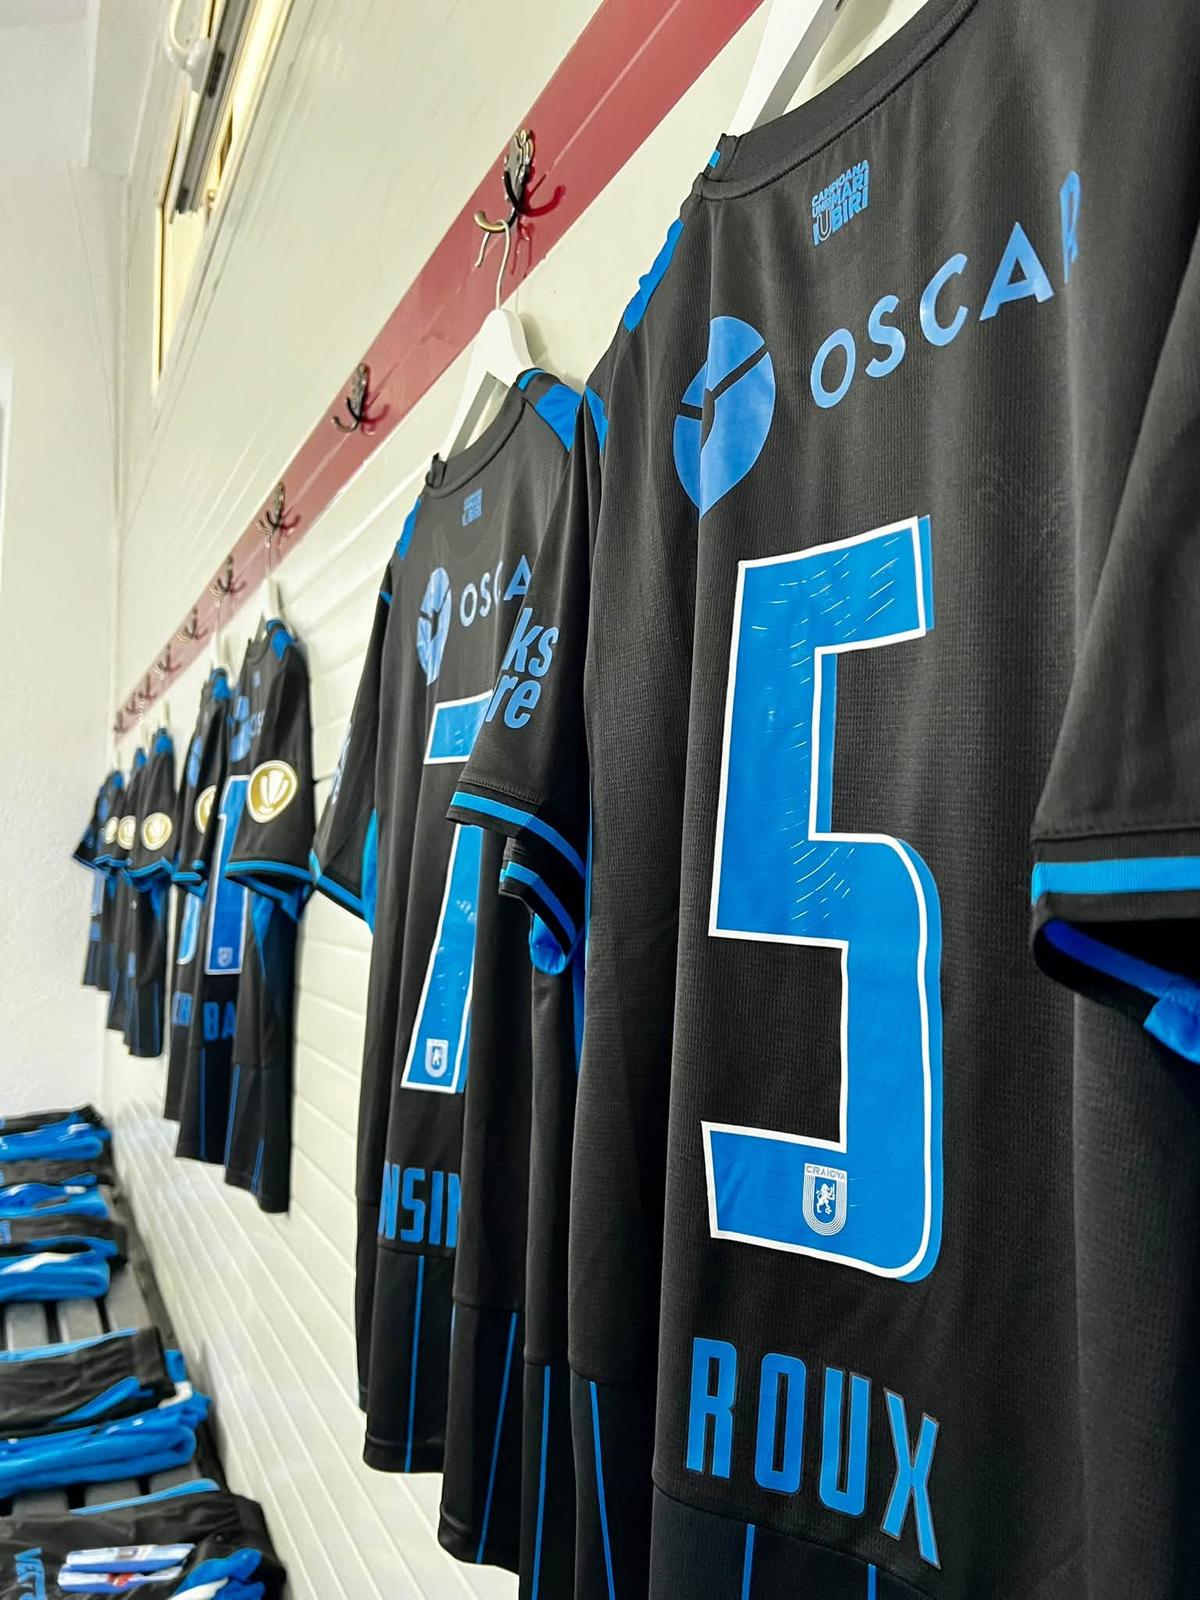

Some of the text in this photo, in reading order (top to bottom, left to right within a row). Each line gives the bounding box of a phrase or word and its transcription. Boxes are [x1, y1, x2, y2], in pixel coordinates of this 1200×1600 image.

[812, 186, 869, 246] IUBIRI
[831, 169, 869, 209] MARI
[501, 607, 560, 678] ks
[700, 514, 944, 1283] 5
[686, 1337, 941, 1569] ROUX
